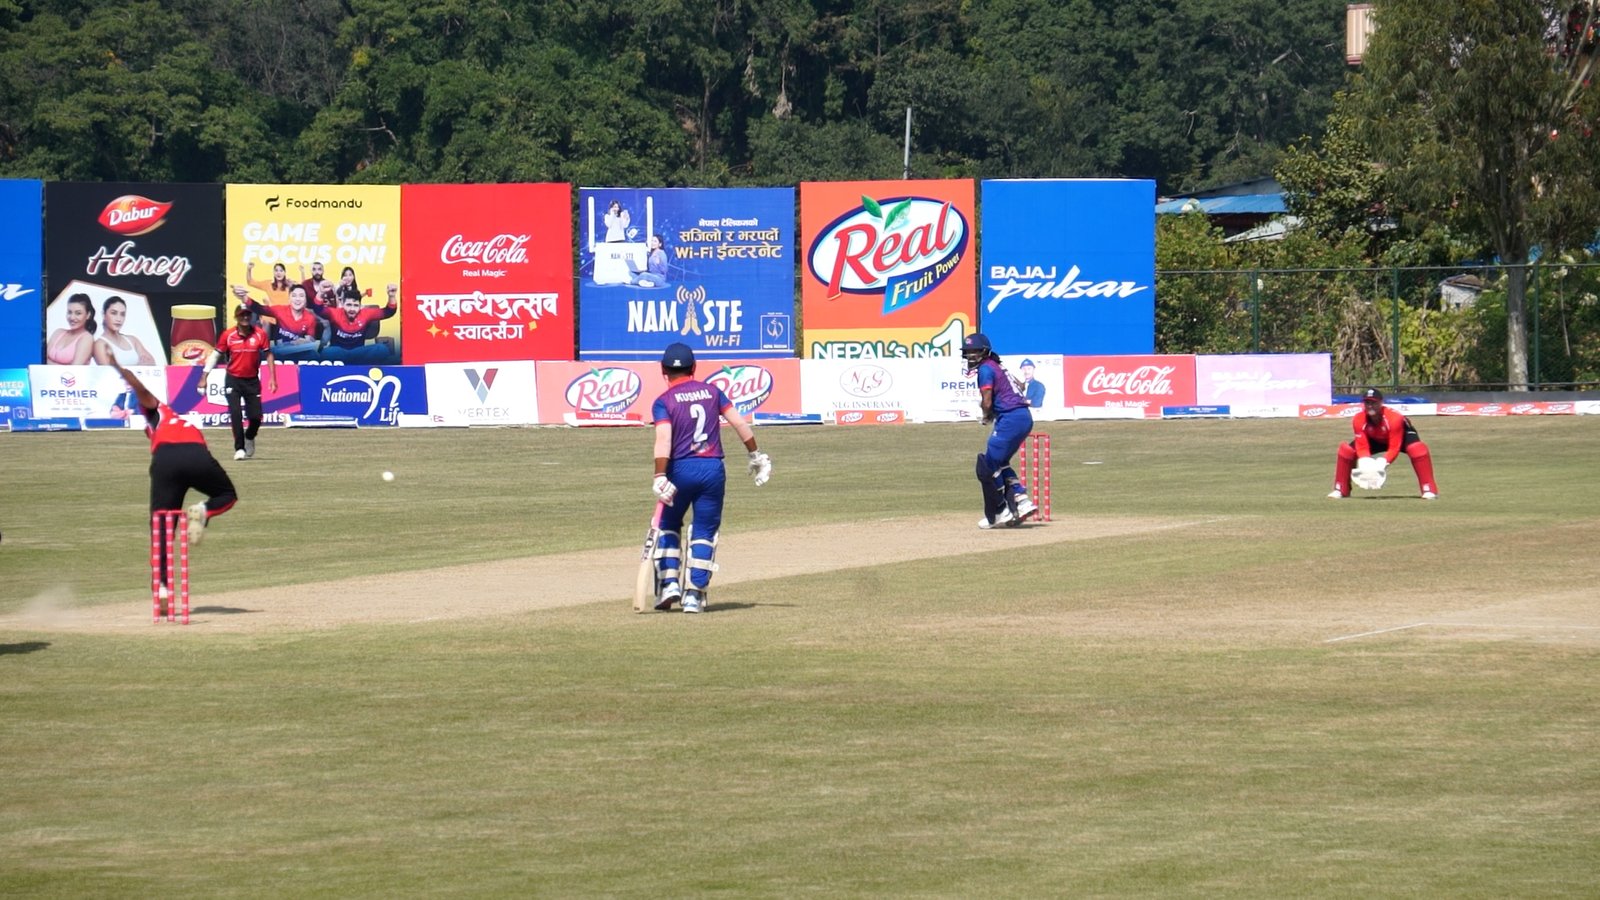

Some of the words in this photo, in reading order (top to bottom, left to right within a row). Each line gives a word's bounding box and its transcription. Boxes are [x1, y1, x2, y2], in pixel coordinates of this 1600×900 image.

[285, 198, 363, 209] Foodmandu
[108, 206, 160, 226] Dabur
[242, 222, 320, 243] GAME
[335, 222, 386, 243] ON!
[679, 228, 722, 242] सजिलो
[726, 230, 735, 242] र
[242, 243, 332, 264] FOCUS
[336, 244, 386, 264] ON!
[440, 234, 531, 264] Coca-Cola
[675, 245, 713, 259] Wi-Fi
[827, 201, 956, 301] Real
[87, 240, 192, 287] Honey
[462, 269, 481, 278] Real
[482, 268, 508, 279] Magic
[890, 271, 935, 307] Fruit
[935, 252, 961, 280] Power
[991, 265, 1057, 279] BAJAJ
[705, 335, 741, 347] Wi-Fi
[1082, 365, 1176, 396] Coca-Cola
[40, 389, 98, 398] PREMIER
[320, 387, 371, 403] National
[575, 371, 635, 413] Real
[674, 388, 713, 403] KUSHAL
[55, 398, 85, 406] STEEL
[738, 399, 757, 413] Fruit
[1104, 400, 1125, 408] Real
[1126, 400, 1151, 408] Magic
[457, 407, 510, 418] VERTEX
[689, 403, 709, 443] 2
